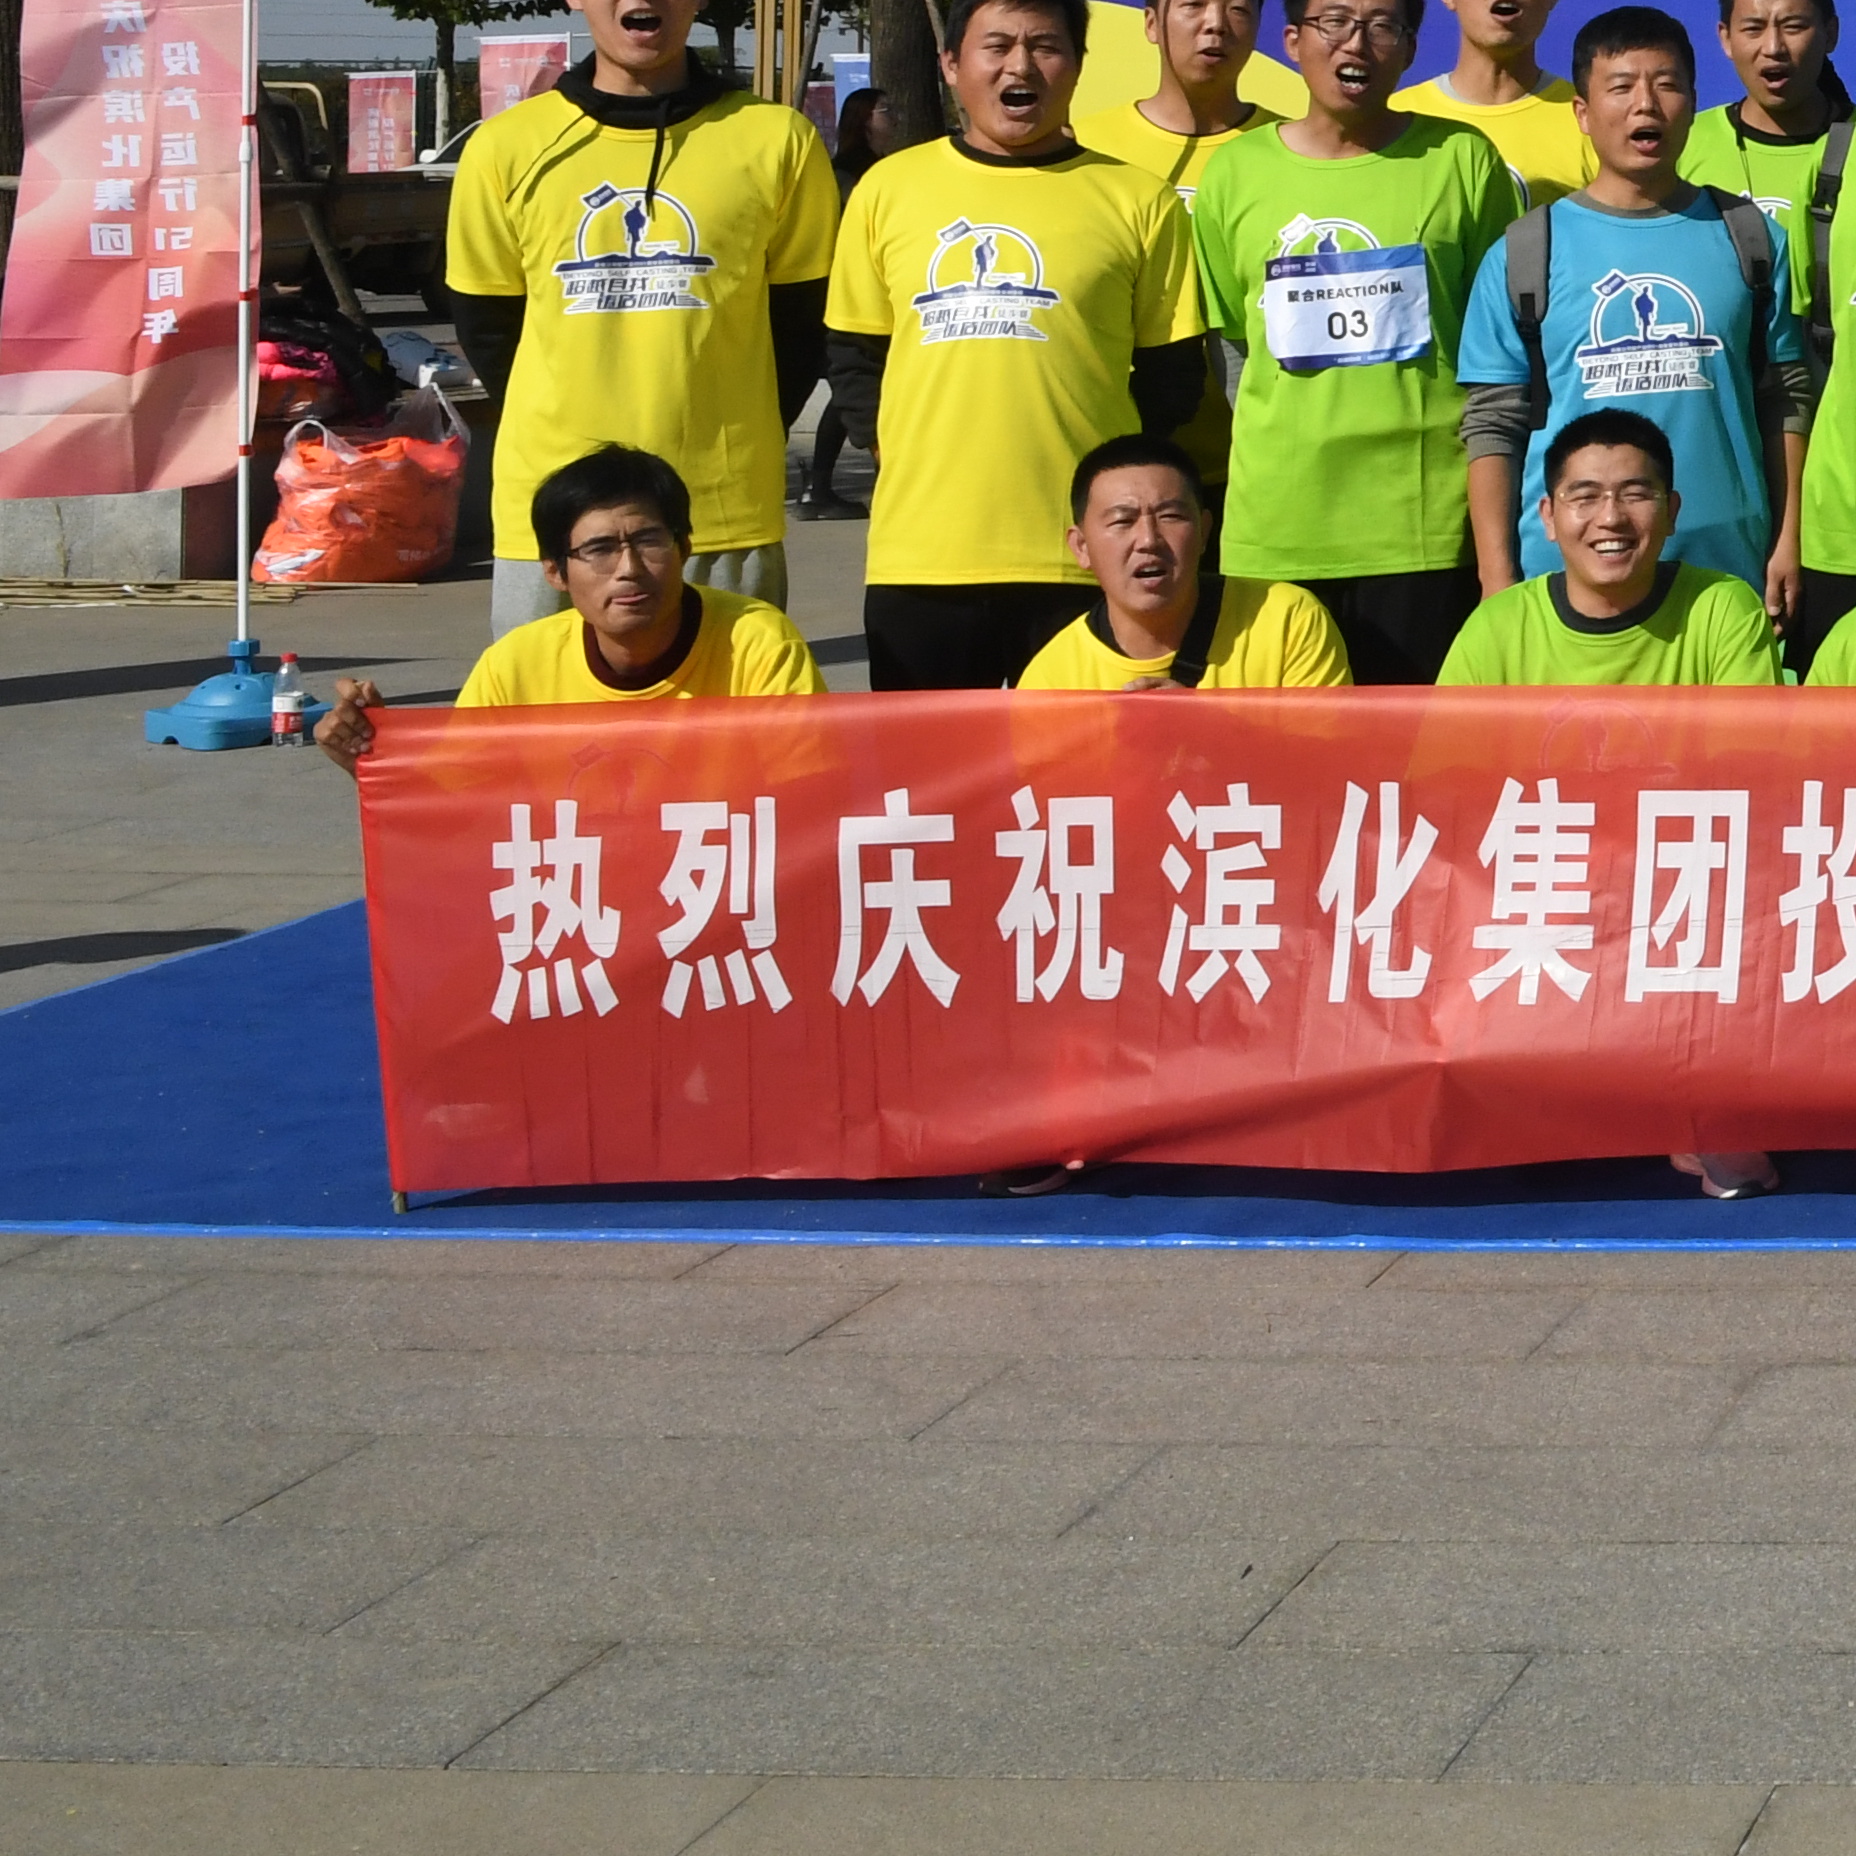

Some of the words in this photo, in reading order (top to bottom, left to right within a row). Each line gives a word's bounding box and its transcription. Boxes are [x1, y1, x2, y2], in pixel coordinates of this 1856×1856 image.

[1286, 280, 1404, 304] 聚合REACTION队
[1327, 309, 1369, 340] 03
